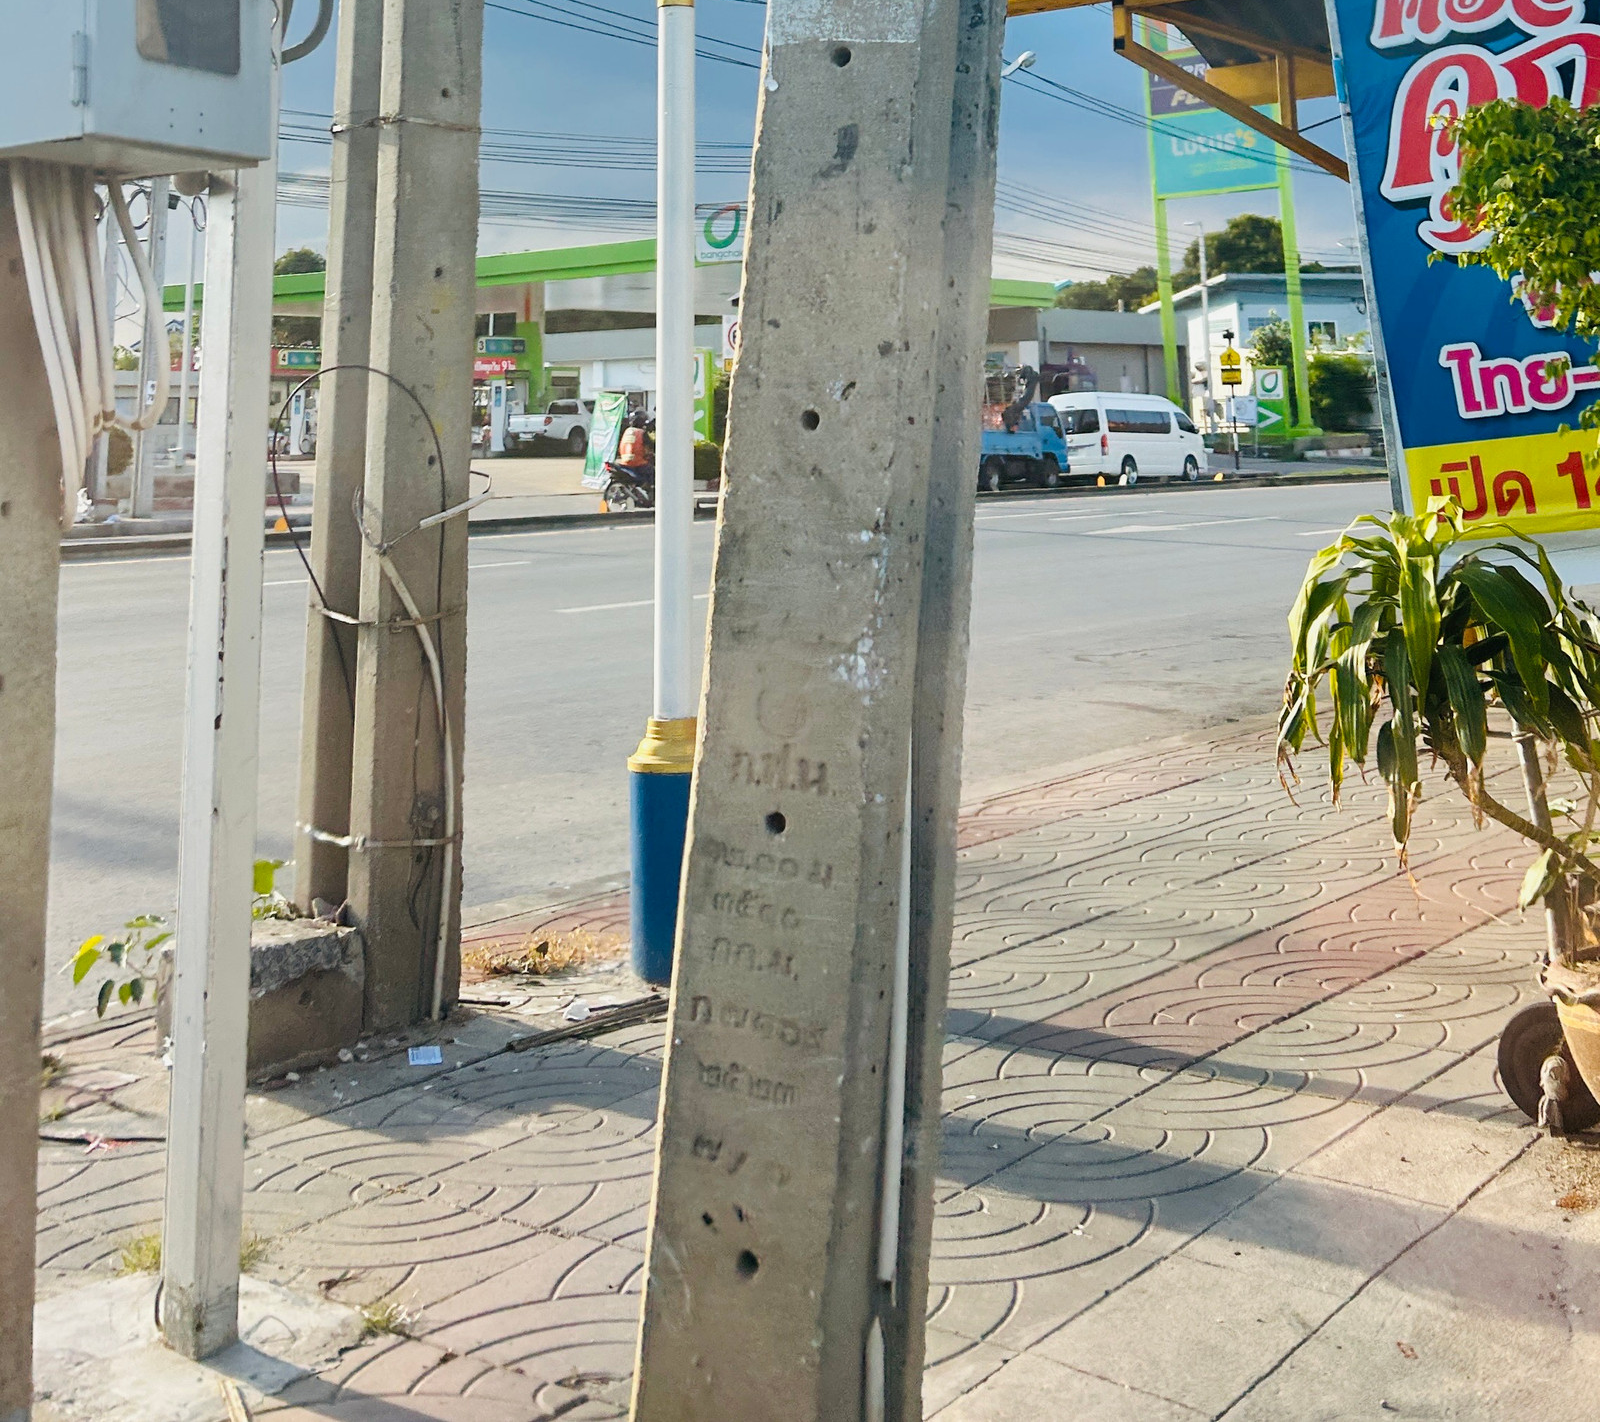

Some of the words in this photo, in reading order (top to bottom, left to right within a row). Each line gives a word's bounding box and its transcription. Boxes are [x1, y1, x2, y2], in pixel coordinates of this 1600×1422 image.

[700, 250, 743, 260] bangcha
[478, 340, 485, 351] 3
[1429, 454, 1537, 523] เปิด
[1556, 450, 1600, 510] 1
